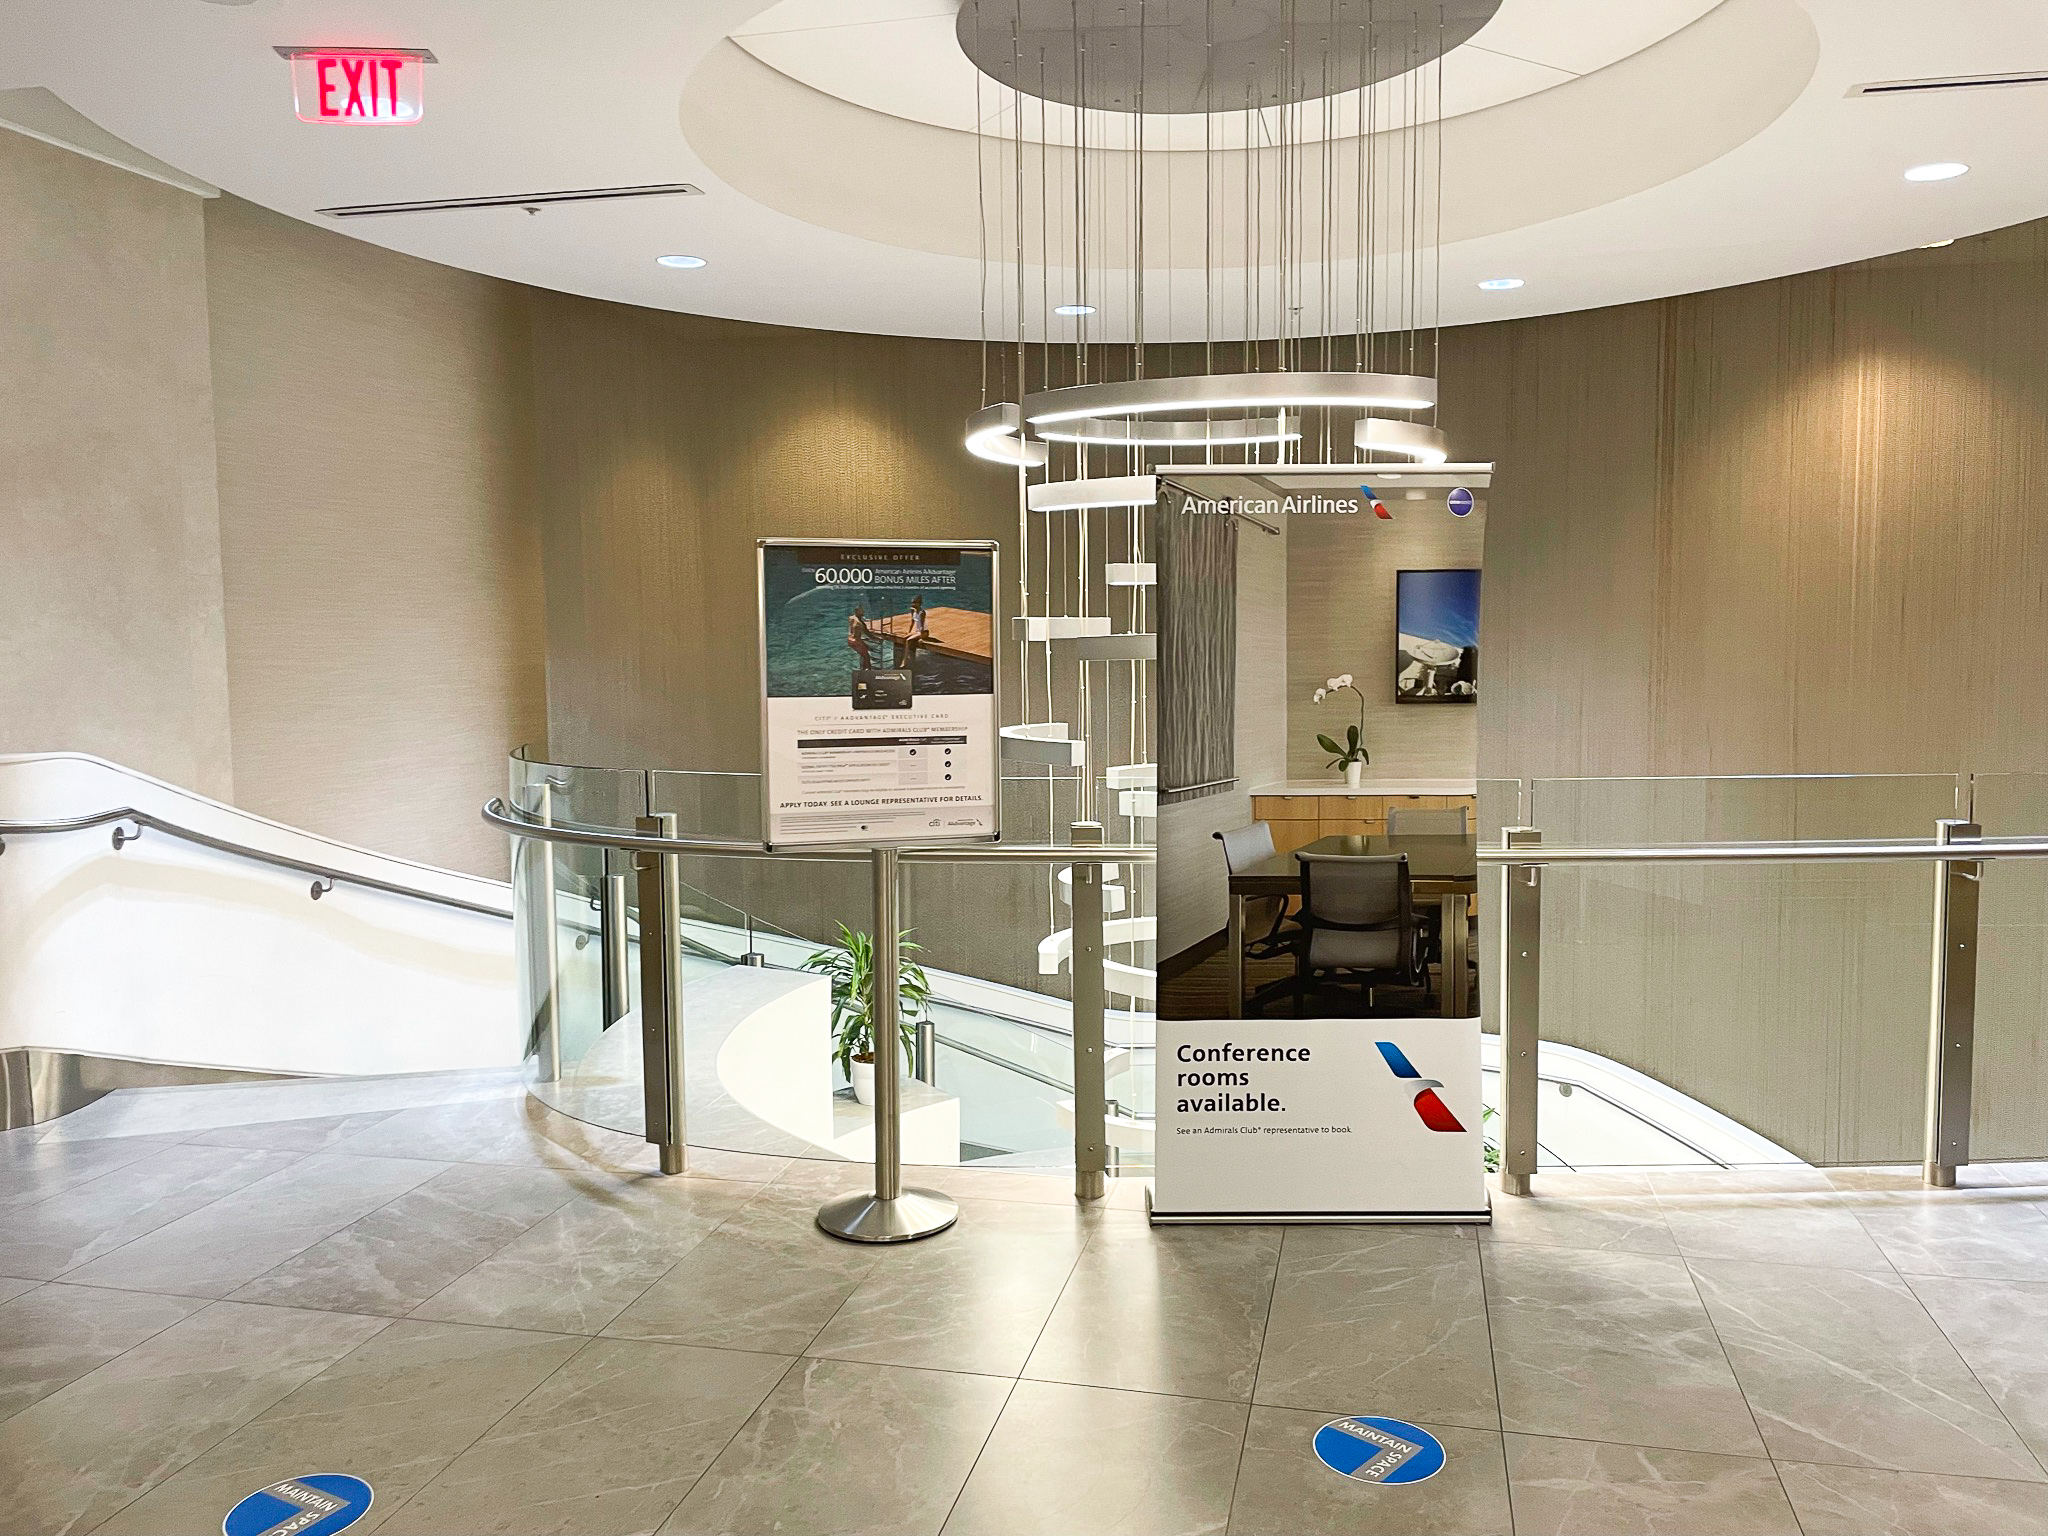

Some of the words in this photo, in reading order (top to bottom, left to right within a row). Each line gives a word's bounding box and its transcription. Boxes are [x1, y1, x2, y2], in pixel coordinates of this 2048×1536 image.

[317, 59, 403, 117] EXIT
[1181, 495, 1279, 515] American
[1281, 495, 1359, 514] Airlines
[874, 575, 904, 584] BONUS
[906, 575, 930, 584] MILES
[931, 575, 956, 584] AFTER
[851, 798, 880, 806] LOUNGE
[881, 796, 938, 804] REPRESENTATIVE
[1176, 1043, 1311, 1063] Conference
[1177, 1072, 1249, 1087] rooms
[1176, 1093, 1287, 1113] available.
[1176, 1127, 1191, 1135] See
[1204, 1126, 1239, 1134] Admirals
[1263, 1126, 1320, 1135] representative
[1338, 1421, 1412, 1453] MAINTAIN
[1365, 1451, 1403, 1478] SPACE
[273, 1483, 338, 1511] MAINTAIN
[268, 1511, 320, 1536] SPAC
